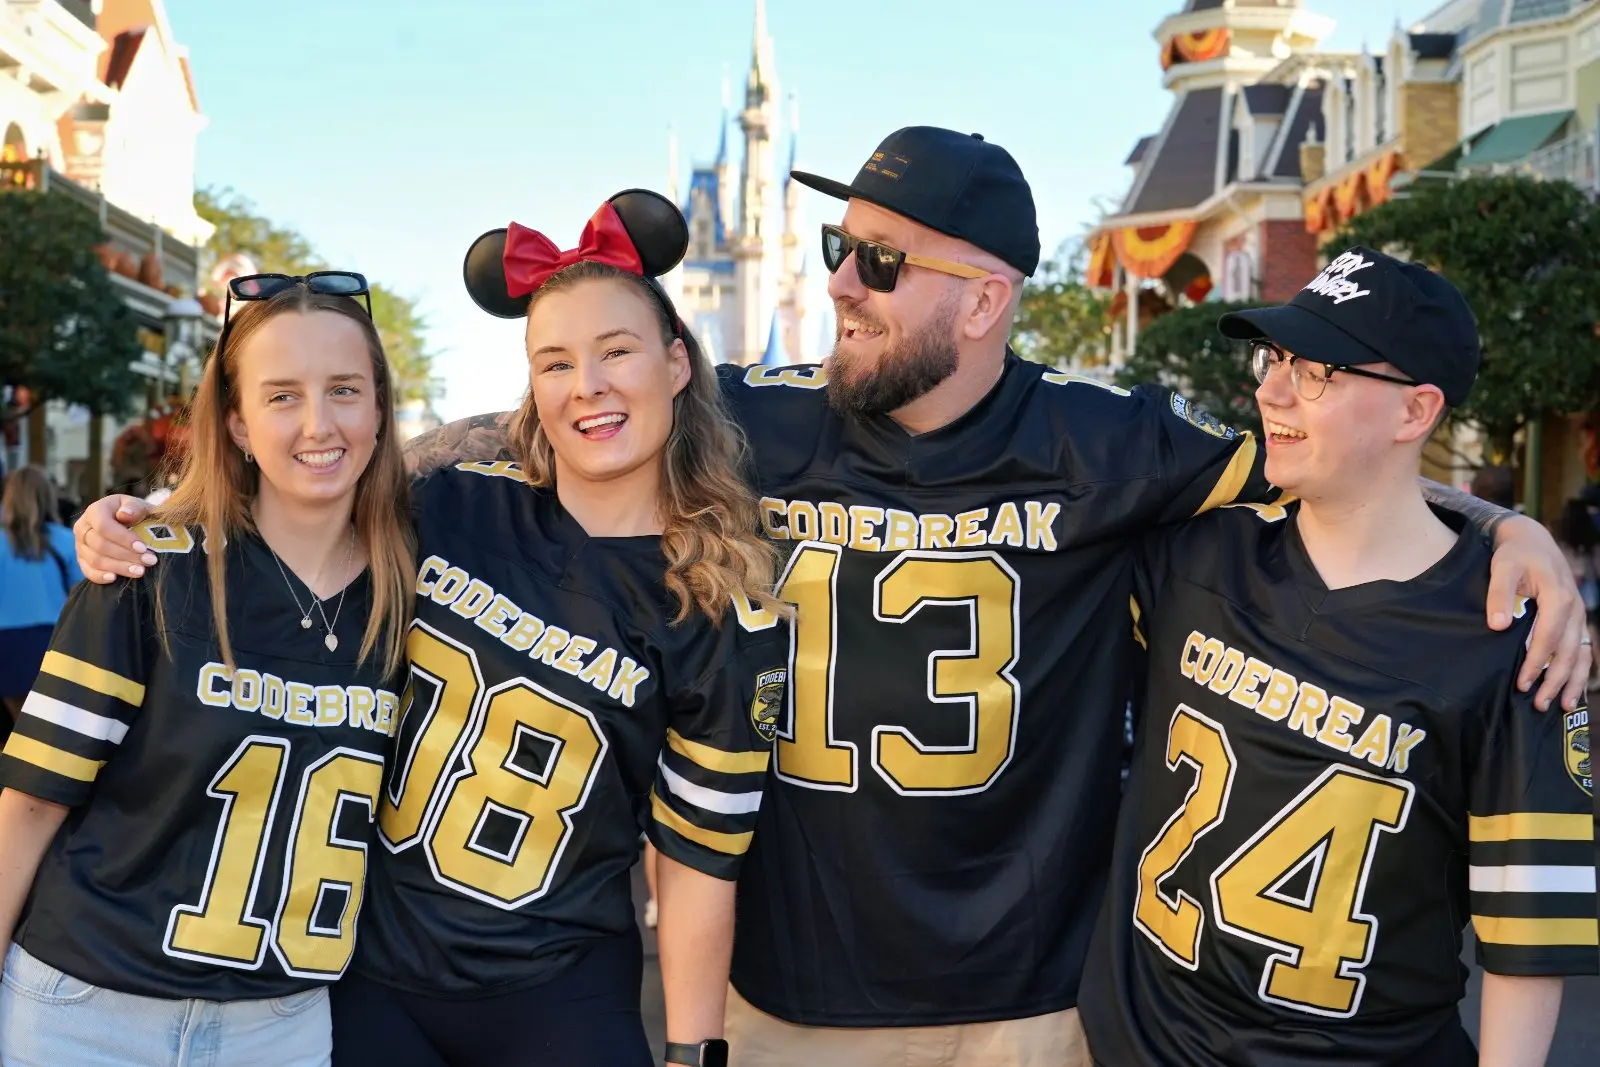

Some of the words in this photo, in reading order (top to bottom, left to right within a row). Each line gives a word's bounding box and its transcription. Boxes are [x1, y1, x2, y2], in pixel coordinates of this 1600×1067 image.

[759, 496, 1061, 552] CODEBREAK
[197, 661, 399, 738] CODEBRE
[416, 555, 650, 707] CODEBREAK
[774, 540, 1021, 797] 13
[1180, 630, 1426, 773] CODEBREAK
[163, 736, 386, 979] 16
[377, 617, 610, 911] 08
[1133, 702, 1416, 1019] 24
